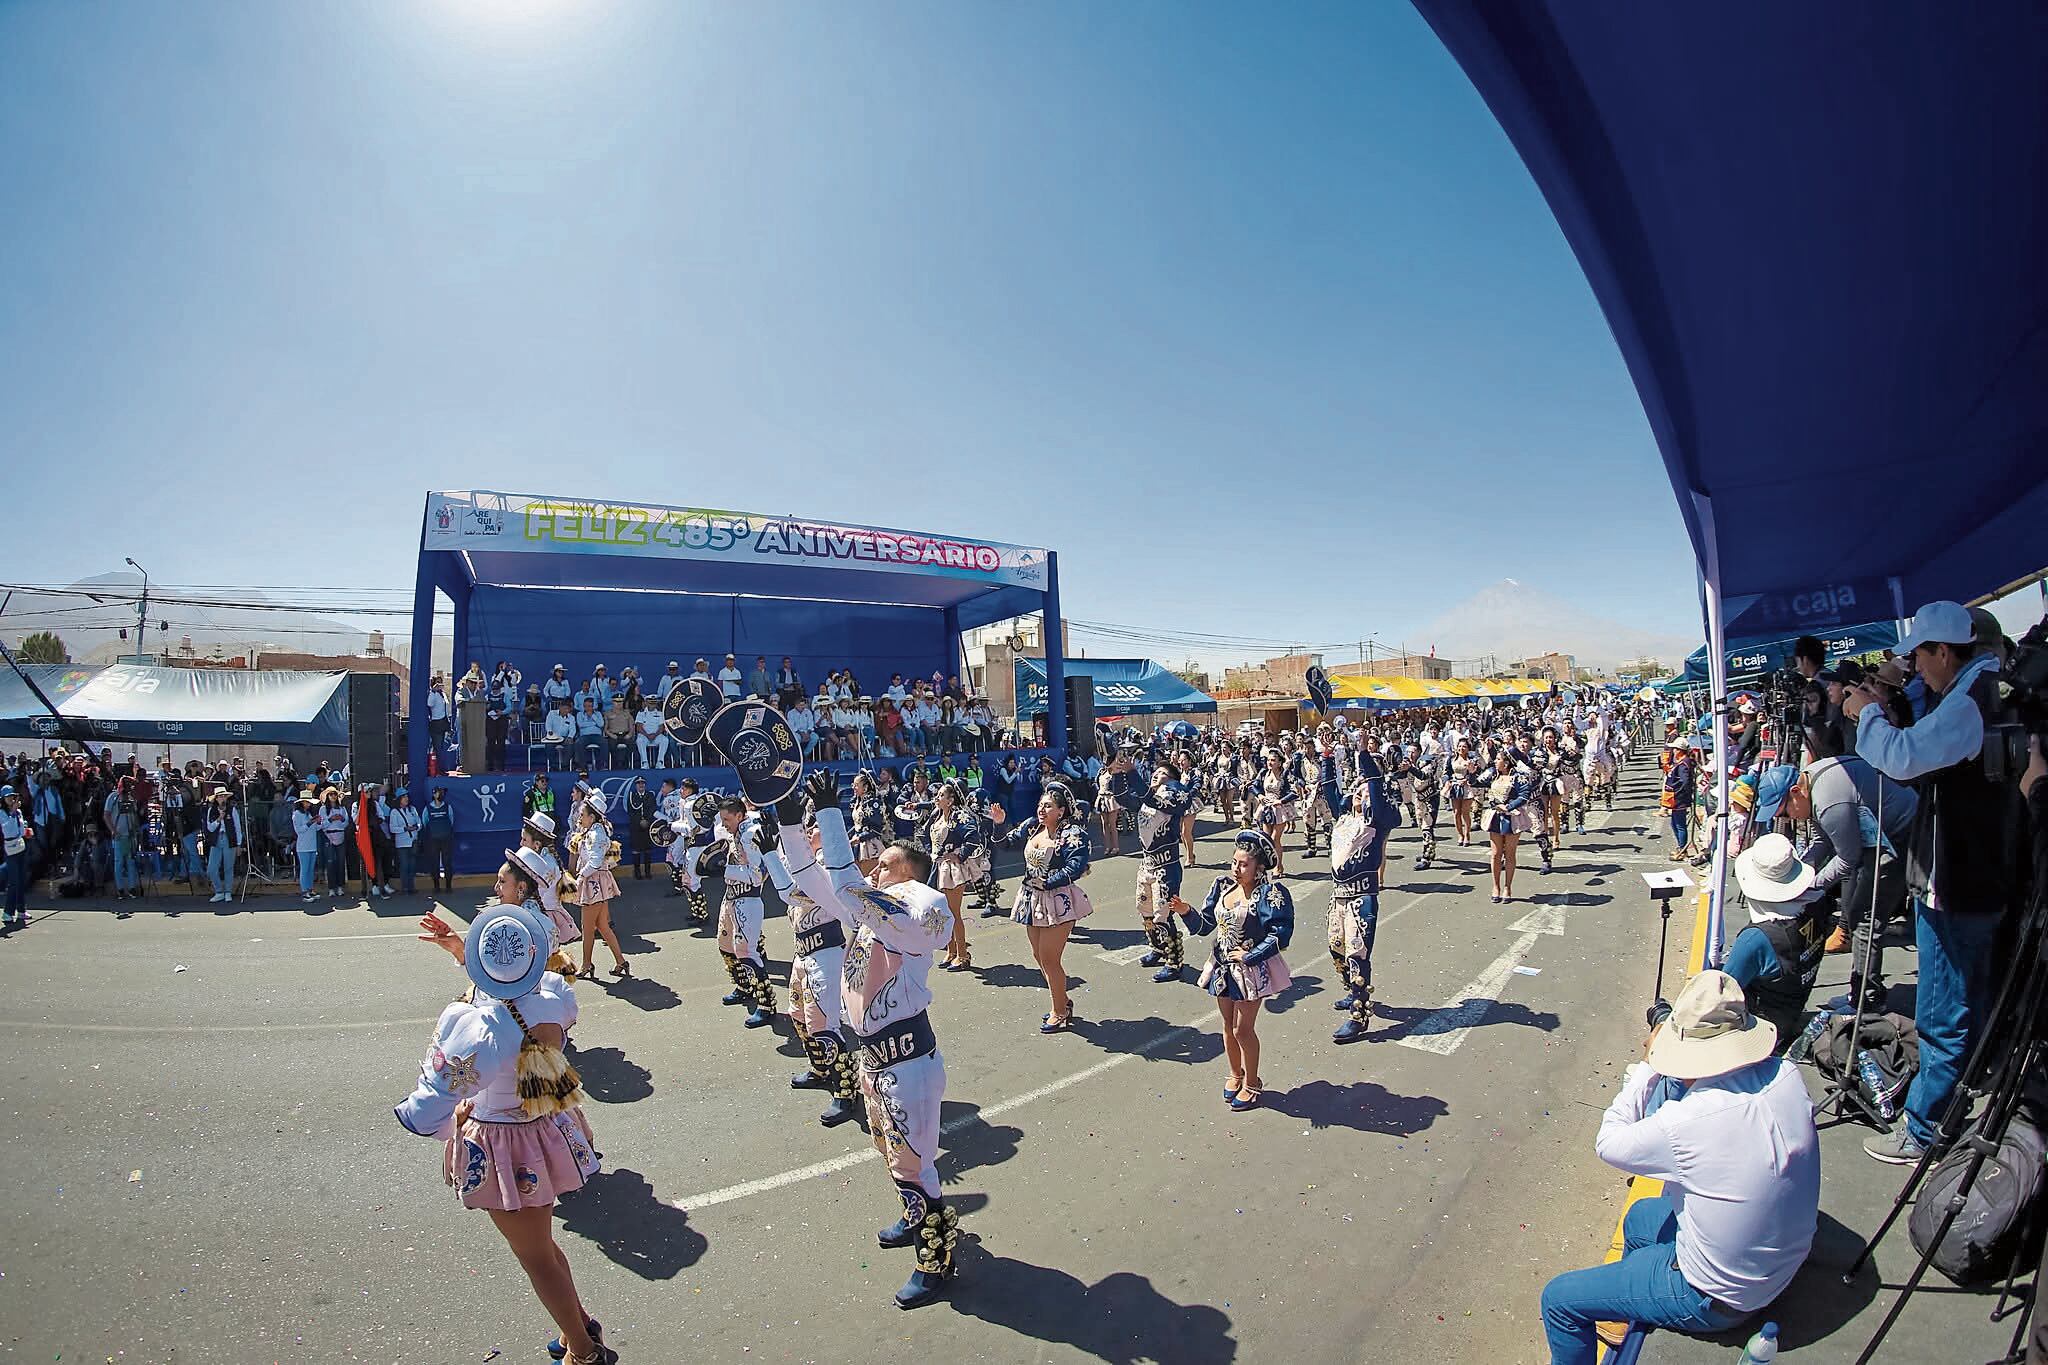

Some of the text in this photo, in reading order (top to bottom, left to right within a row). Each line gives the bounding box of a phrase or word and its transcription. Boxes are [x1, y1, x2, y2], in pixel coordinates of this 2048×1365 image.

[464, 509, 489, 518] ARE
[525, 503, 648, 545] FELIZ
[754, 522, 1000, 572] ANIVERSARIO
[1832, 637, 1856, 650] caja
[1743, 653, 1768, 666] caja
[1094, 682, 1146, 698] caja
[40, 720, 60, 732] caja
[101, 720, 119, 731] caja
[166, 721, 184, 732] caja
[233, 722, 252, 733] caja
